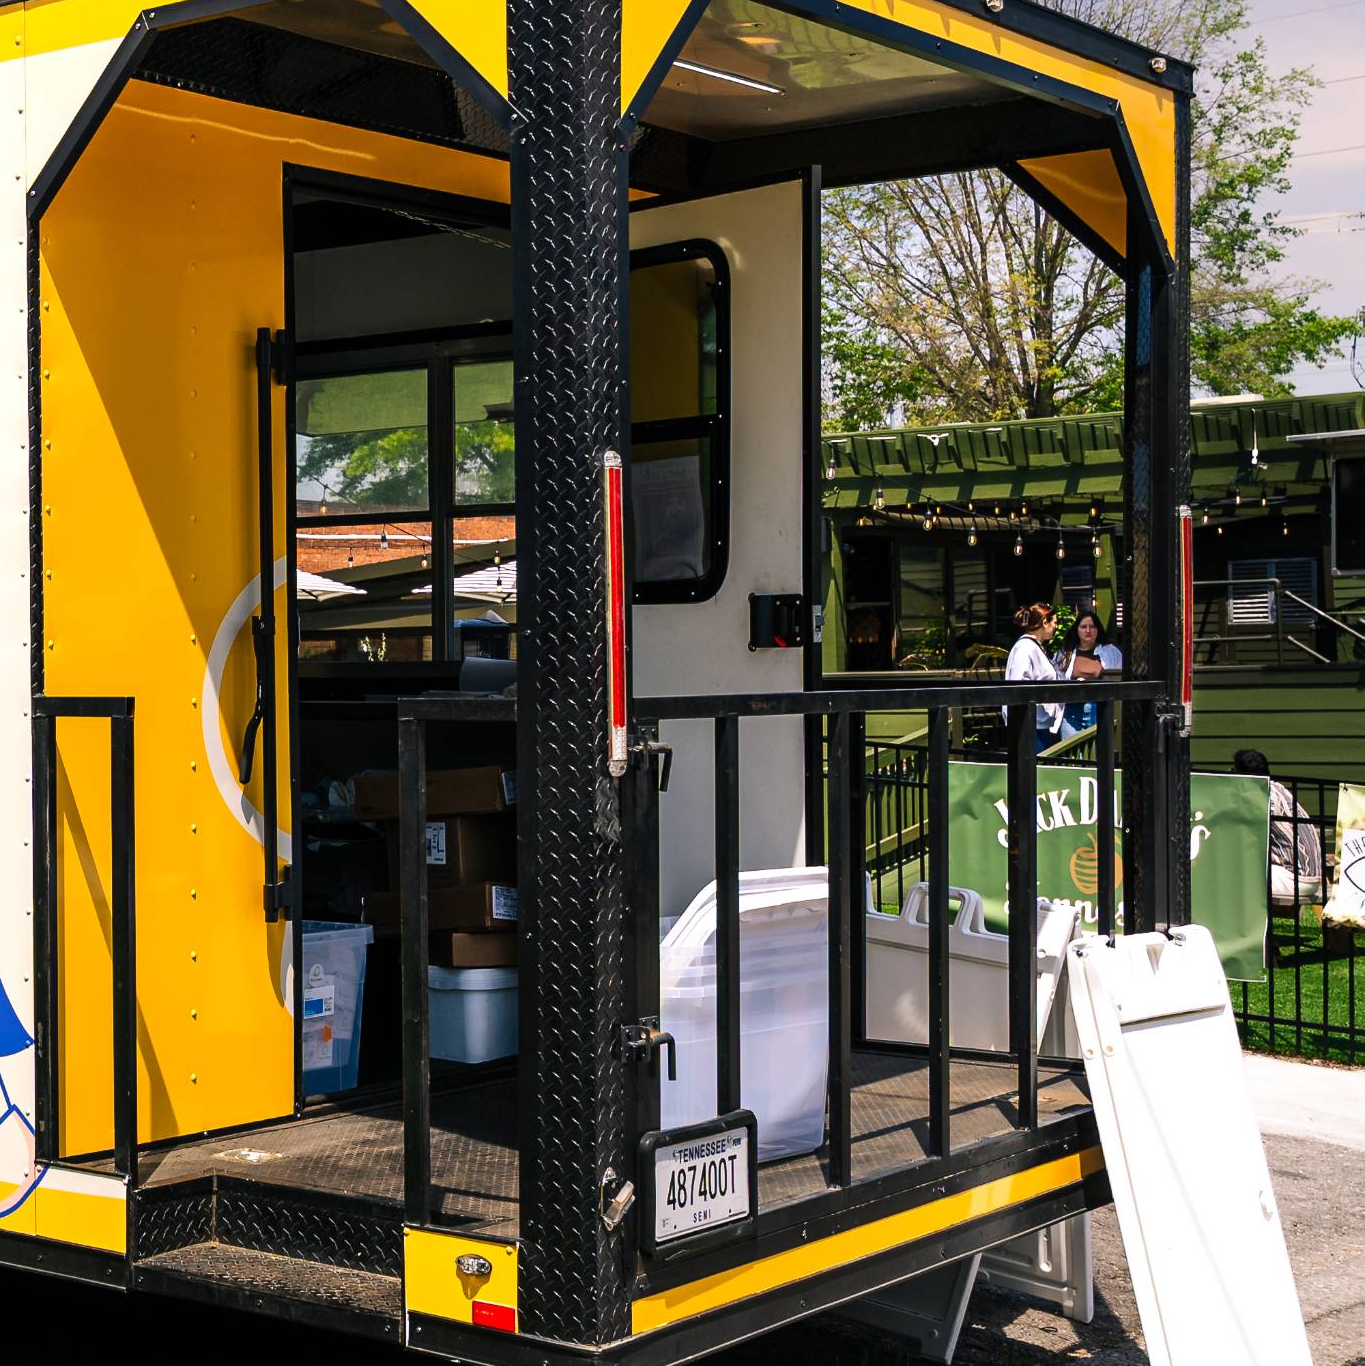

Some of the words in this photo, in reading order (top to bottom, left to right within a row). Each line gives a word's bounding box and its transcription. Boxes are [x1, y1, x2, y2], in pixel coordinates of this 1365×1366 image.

[993, 788, 1078, 849] JCK
[677, 1138, 727, 1164] TENNESSEE
[666, 1154, 738, 1211] 487400T
[693, 1208, 711, 1223] SEMI
